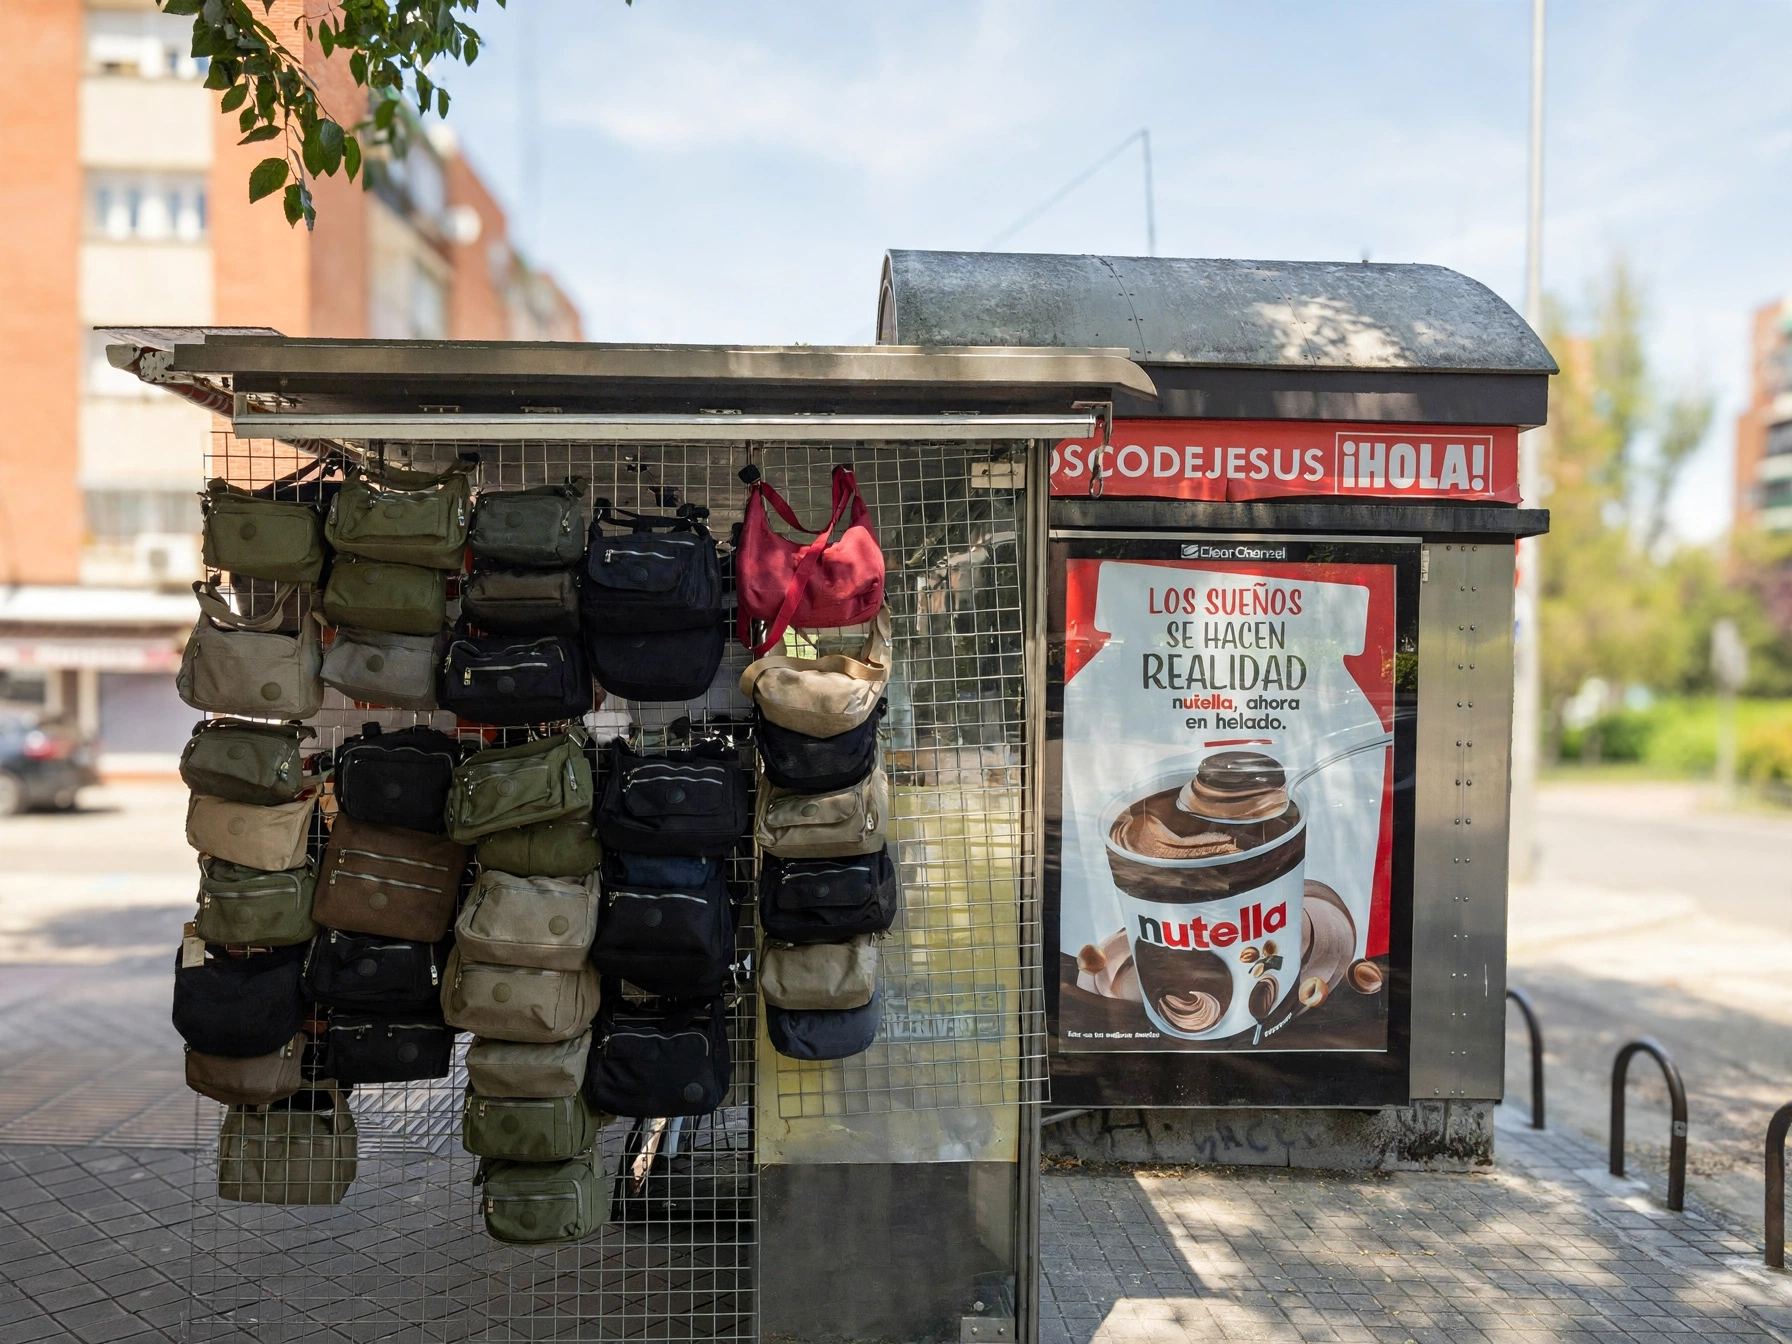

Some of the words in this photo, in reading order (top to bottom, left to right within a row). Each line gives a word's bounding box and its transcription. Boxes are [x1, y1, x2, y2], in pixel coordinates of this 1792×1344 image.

[1343, 440, 1485, 490] ¡HOLA!
[1200, 546, 1234, 559] Clear
[1149, 587, 1196, 615] LOS
[1204, 582, 1303, 616] SUEÑOS
[1166, 620, 1195, 649] SE
[1204, 621, 1285, 650] HACEN
[1142, 653, 1307, 691] REALIDAD
[1172, 694, 1238, 712] nutella,
[1246, 694, 1300, 711] ahora
[1185, 717, 1208, 730] en
[1215, 713, 1287, 730] helado.
[1137, 901, 1288, 950] nutella
